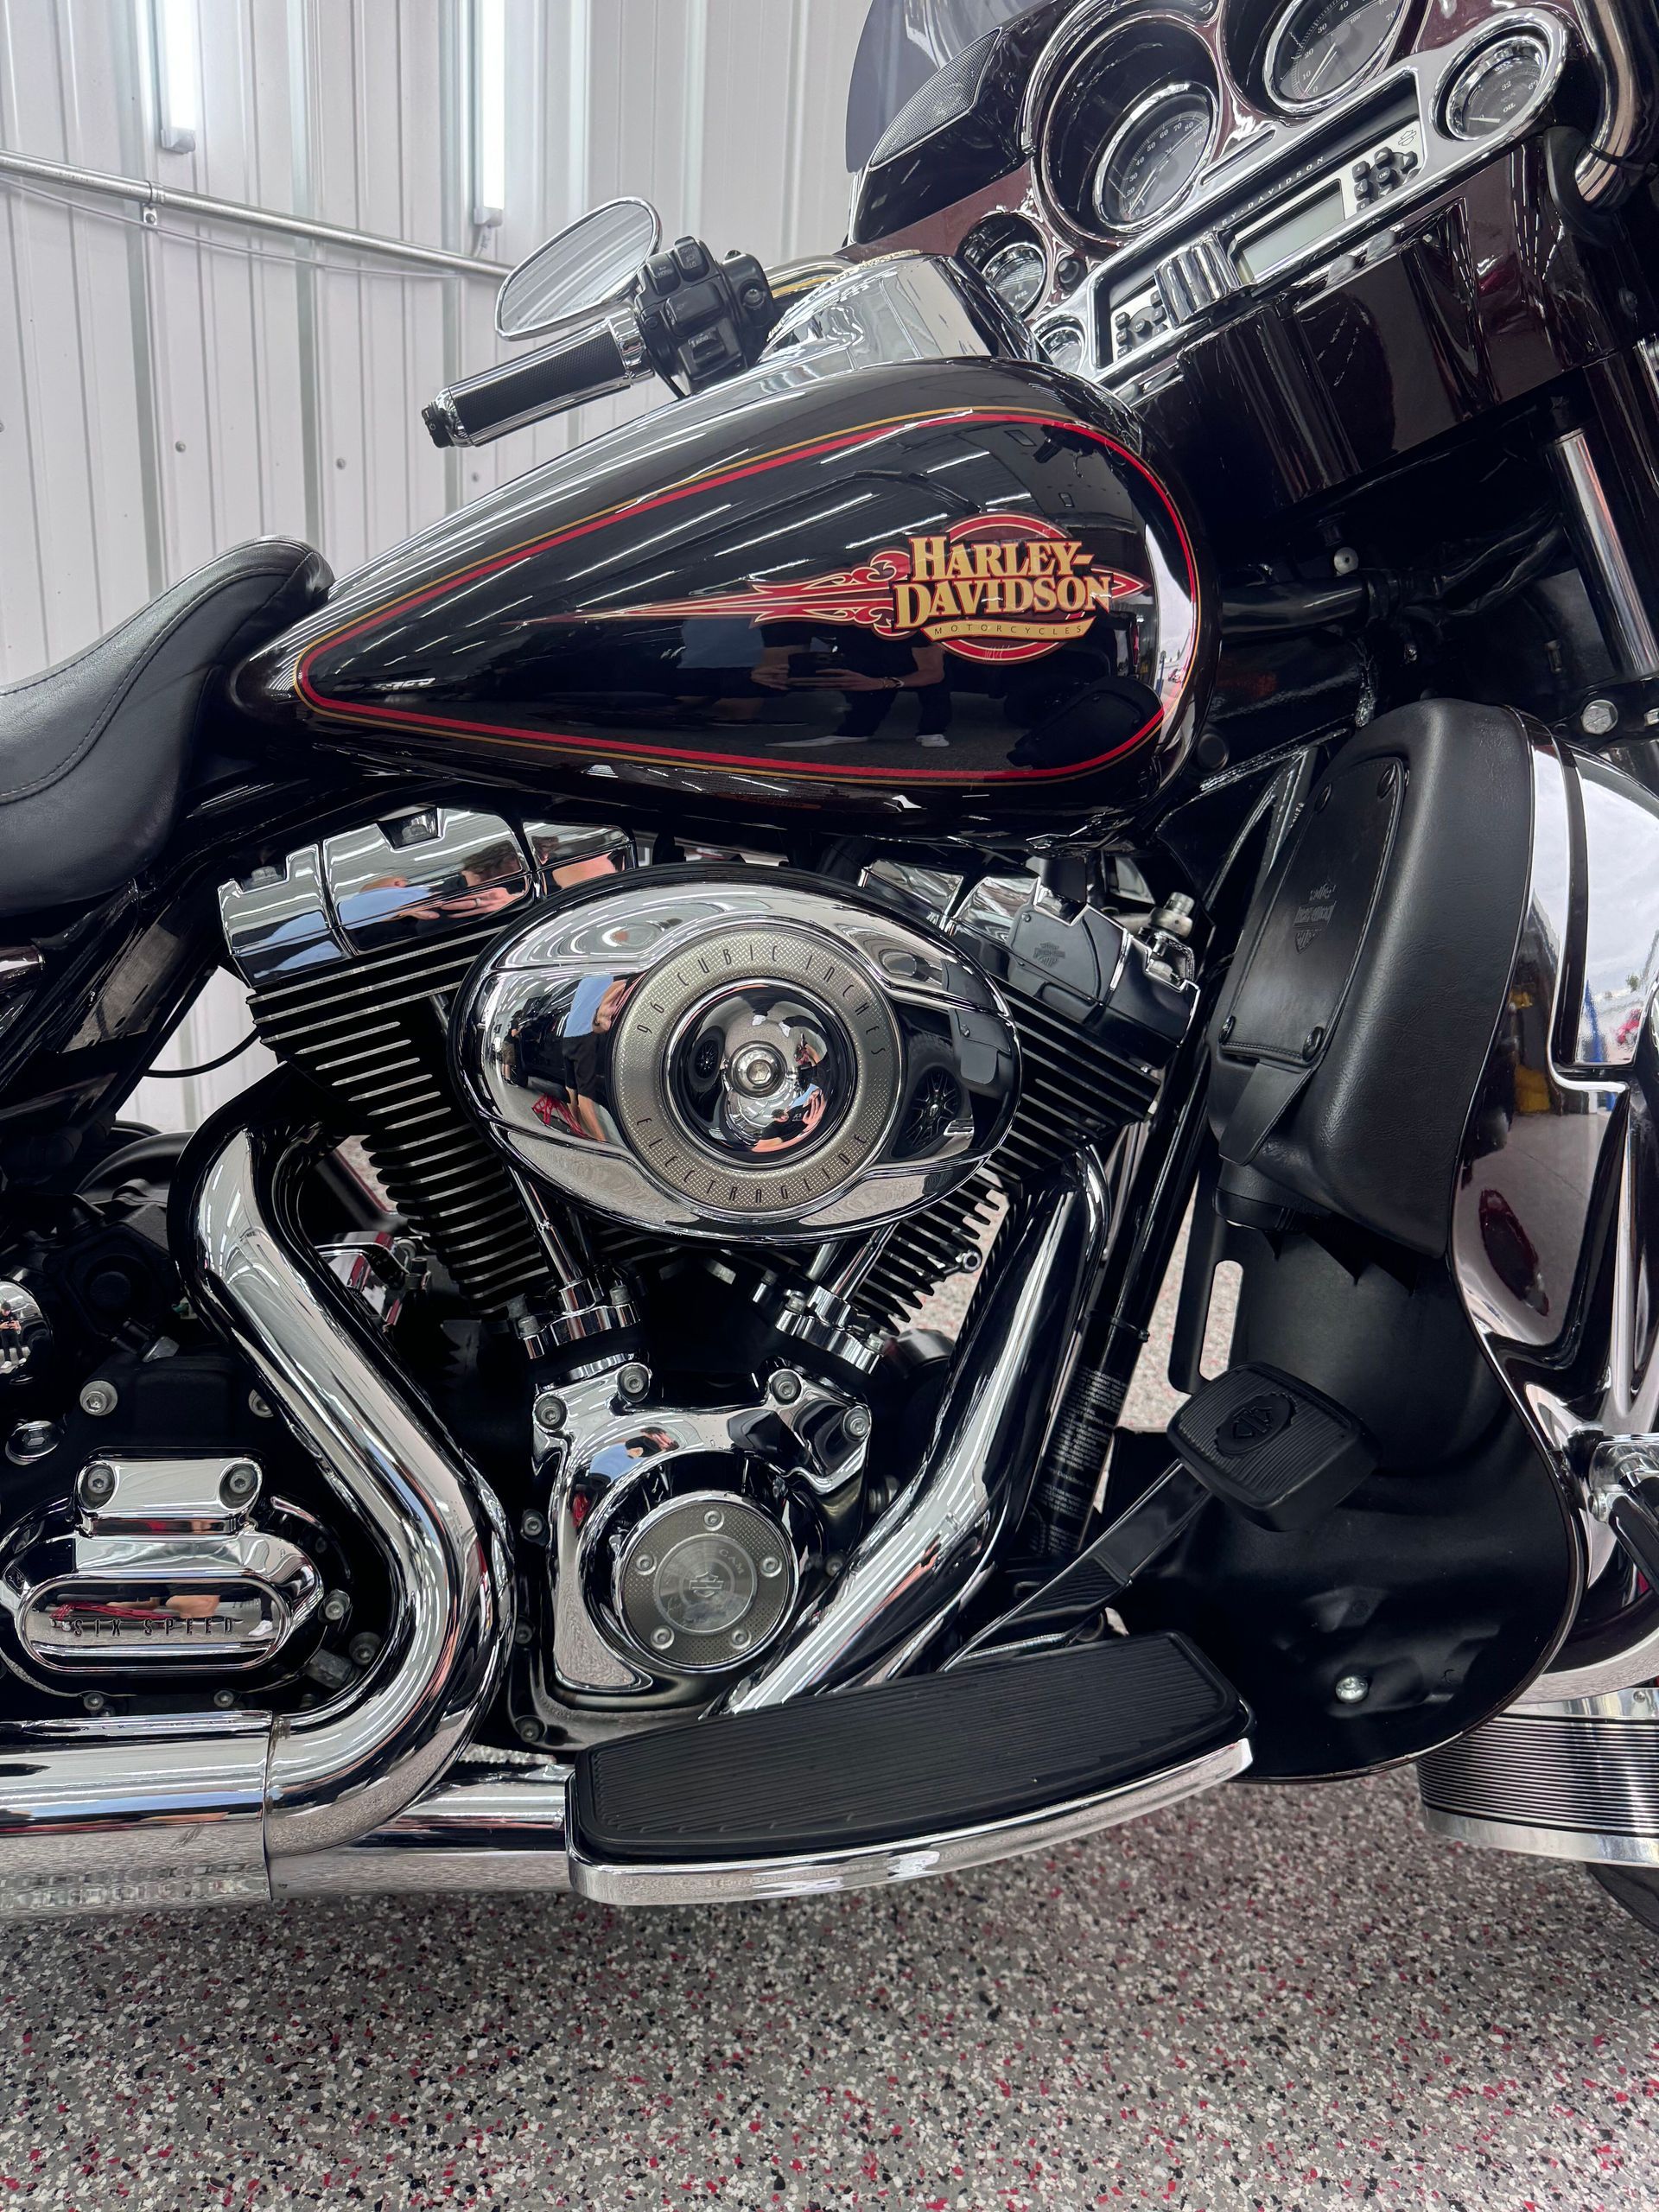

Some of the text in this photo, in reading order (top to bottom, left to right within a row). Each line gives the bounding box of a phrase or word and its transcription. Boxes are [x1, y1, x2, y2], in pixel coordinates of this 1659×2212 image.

[1317, 22, 1328, 34] 30
[1304, 48, 1314, 59] 20
[1302, 71, 1312, 80] 10
[1173, 122, 1183, 132] 70
[1159, 130, 1169, 139] 60
[1128, 173, 1139, 182] 30
[909, 536, 1095, 582] HARLEY-
[892, 575, 1113, 629] DAVIDSON
[934, 623, 1084, 636] MOTORCYCLES
[677, 944, 779, 987] CUBIC
[805, 955, 887, 1056] INCHES
[73, 1617, 234, 1638] SIX SPEED
